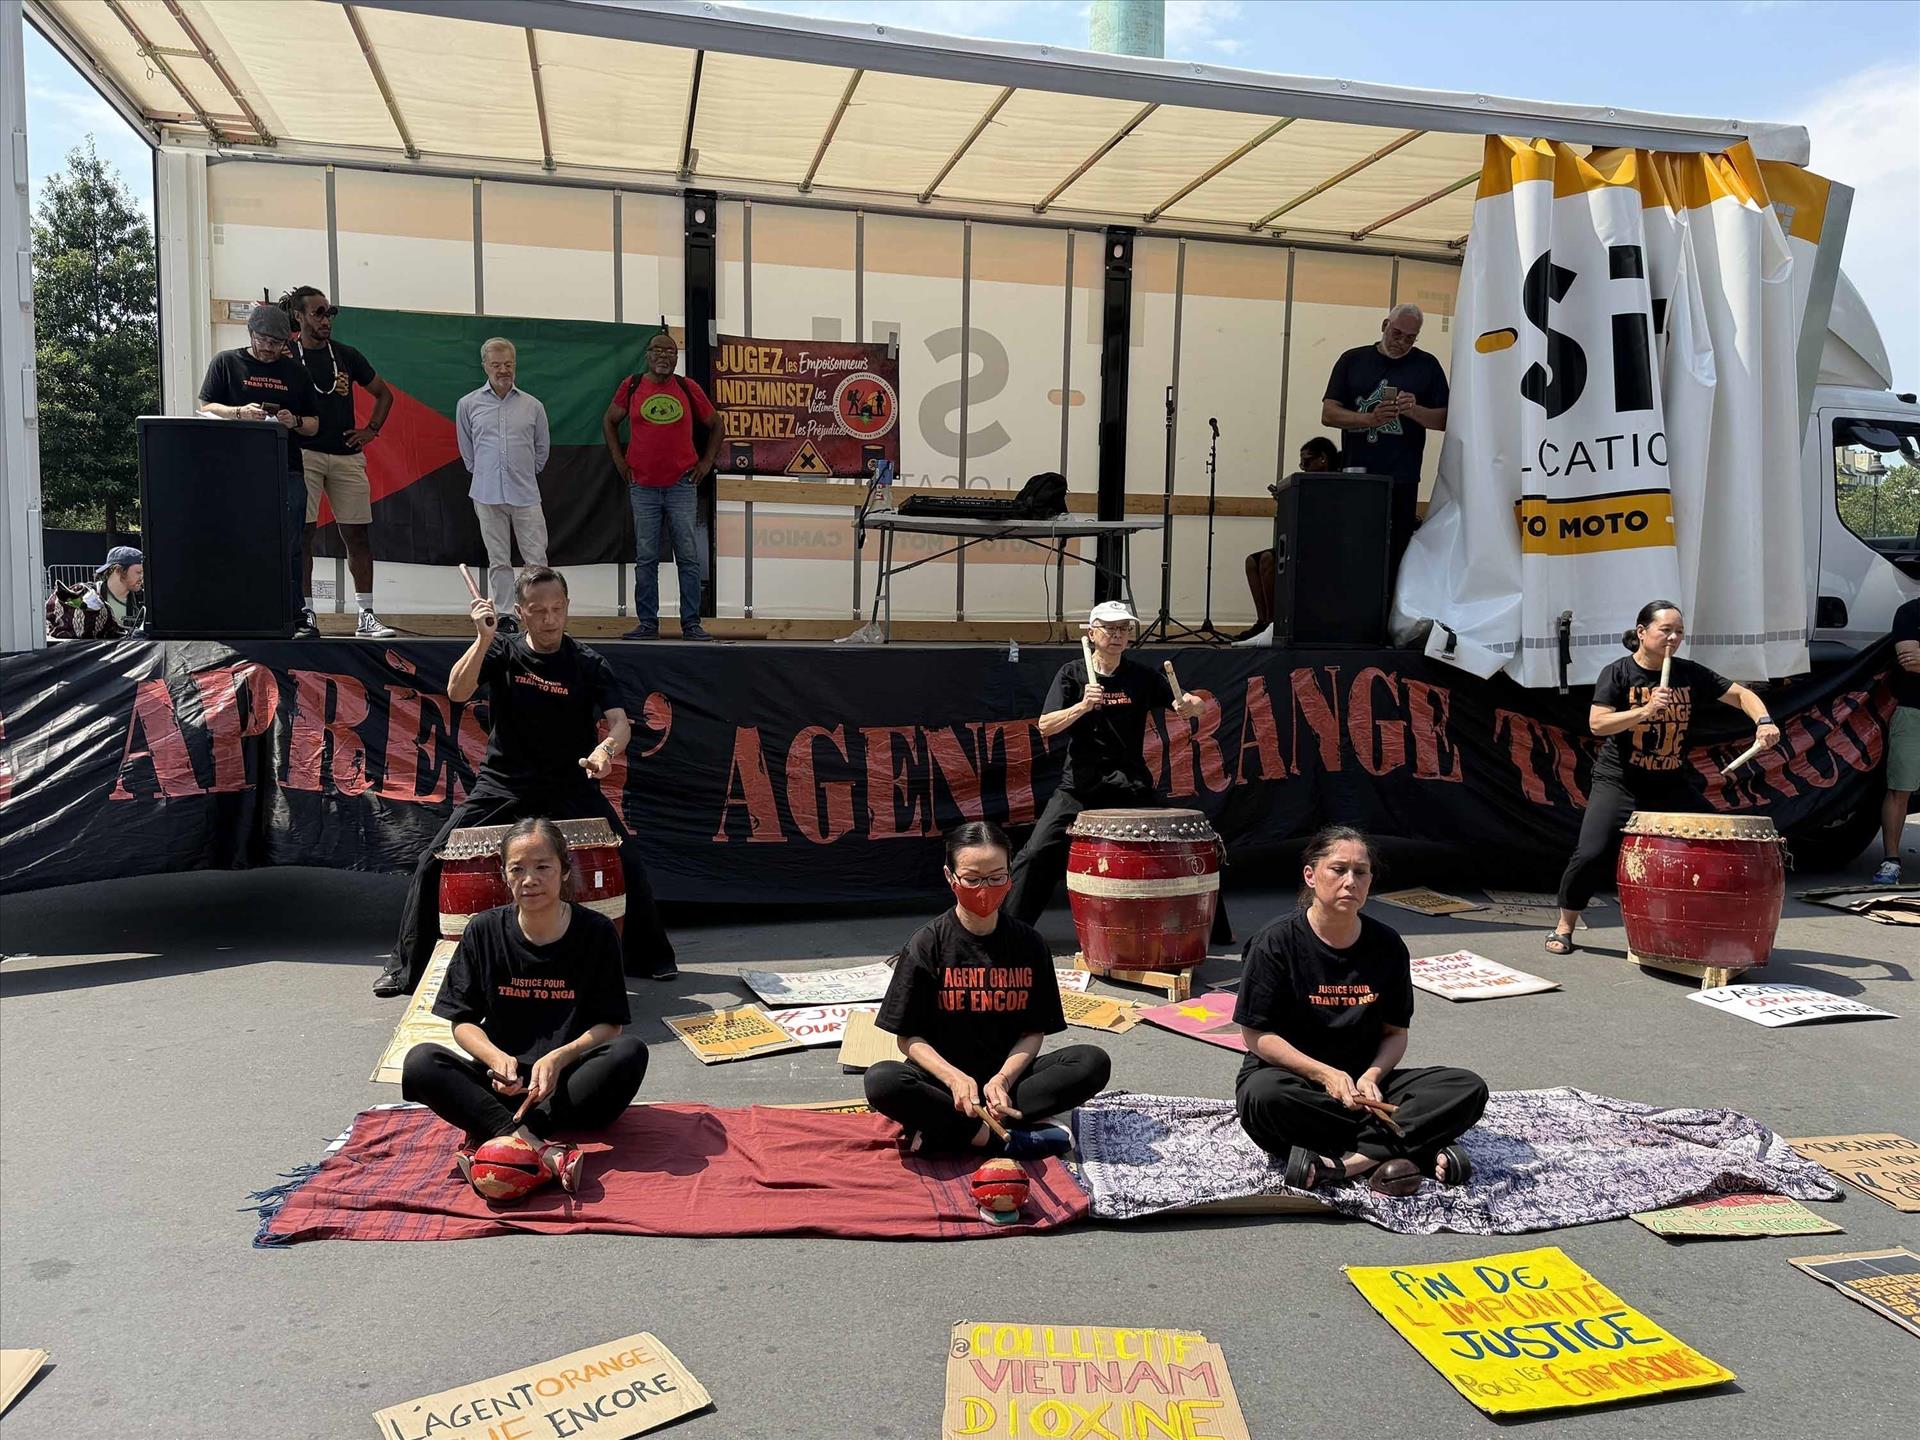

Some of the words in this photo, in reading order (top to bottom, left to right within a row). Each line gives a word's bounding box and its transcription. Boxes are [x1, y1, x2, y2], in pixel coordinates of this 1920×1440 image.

[716, 344, 783, 375] JUGEZ
[785, 358, 798, 373] les
[716, 379, 814, 407] INDEMNISEZ
[815, 388, 826, 400] les
[720, 411, 795, 439] REPAREZ
[795, 424, 806, 436] les
[1558, 510, 1649, 539] MOTO
[712, 717, 1050, 844] AGENT
[498, 986, 530, 998] TRAN
[533, 990, 548, 999] TO
[551, 990, 576, 999] NGA
[511, 977, 542, 987] JUSTICE
[543, 979, 566, 988] POUR
[1318, 985, 1348, 994] JUSTICE
[1349, 985, 1371, 994] POUR
[1309, 994, 1340, 1006] TRAN
[1341, 997, 1357, 1006] TO
[1760, 1006, 1815, 1019] TUE
[1790, 1139, 1919, 1154] MONSANTO
[1846, 1157, 1882, 1168] TU
[1473, 1266, 1549, 1294] DE
[1442, 1311, 1663, 1361] JUSTICE
[969, 1358, 1220, 1398] VIETNAM
[543, 1372, 677, 1439] ENCORE
[952, 1396, 1225, 1440] DIOXINE
